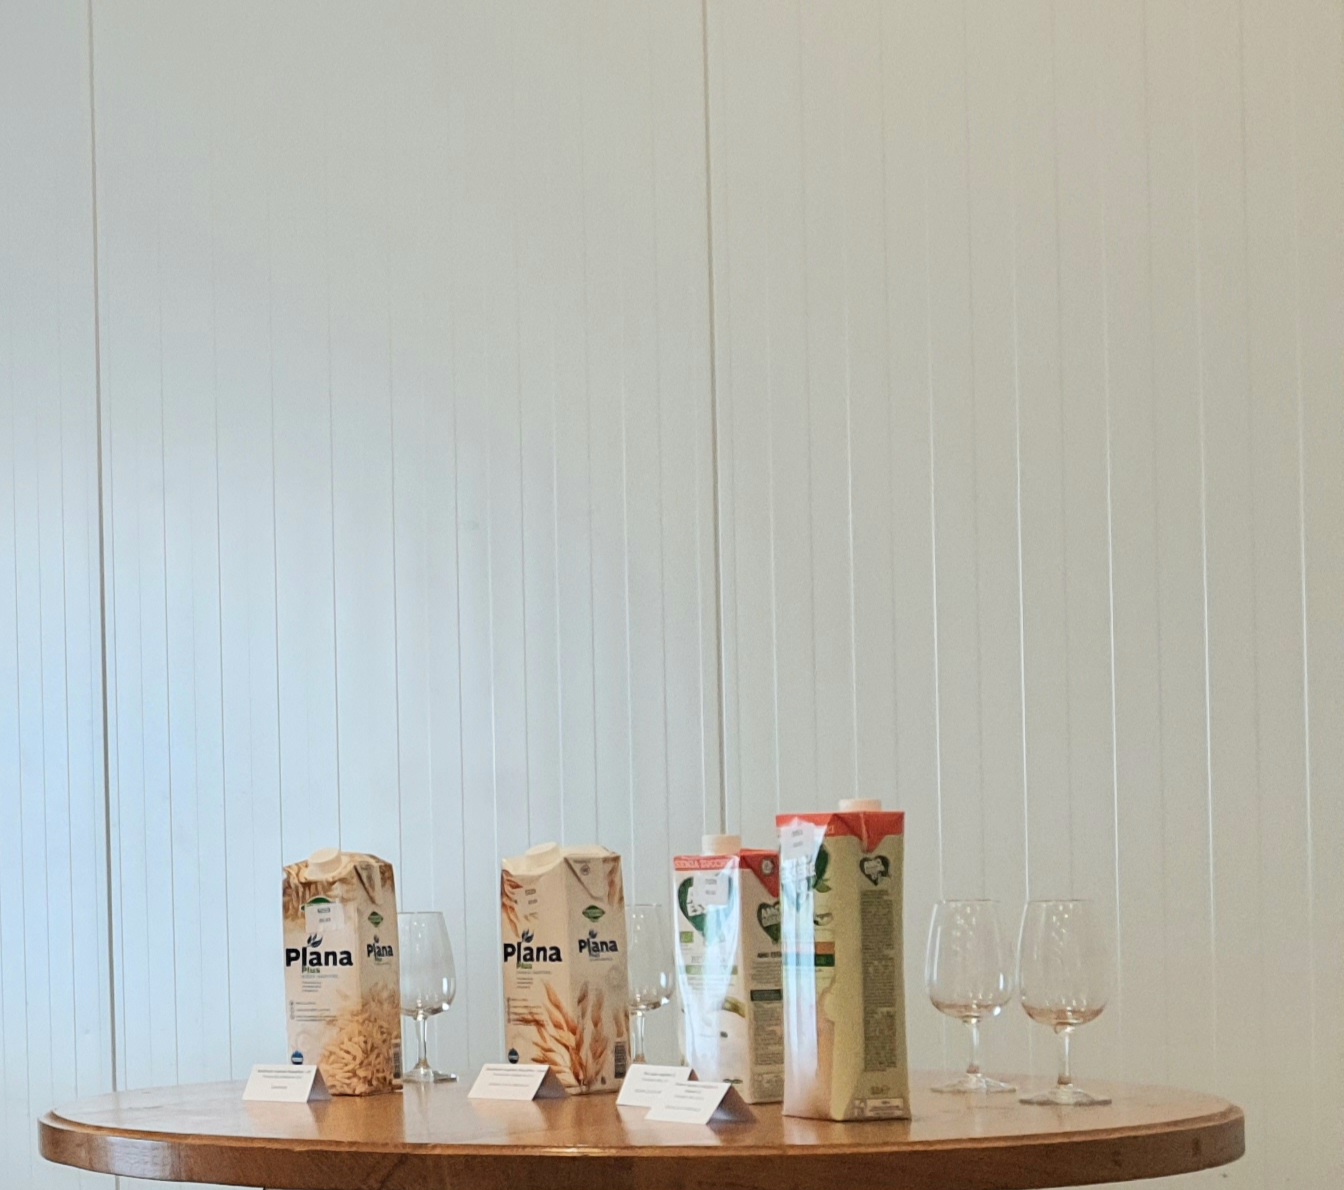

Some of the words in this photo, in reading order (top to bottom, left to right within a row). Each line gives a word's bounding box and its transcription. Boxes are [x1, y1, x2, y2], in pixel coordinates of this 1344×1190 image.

[366, 942, 394, 958] Plana
[503, 941, 563, 963] Plana
[577, 938, 619, 955] Plana
[285, 946, 354, 967] Plana
[301, 966, 321, 974] Plus
